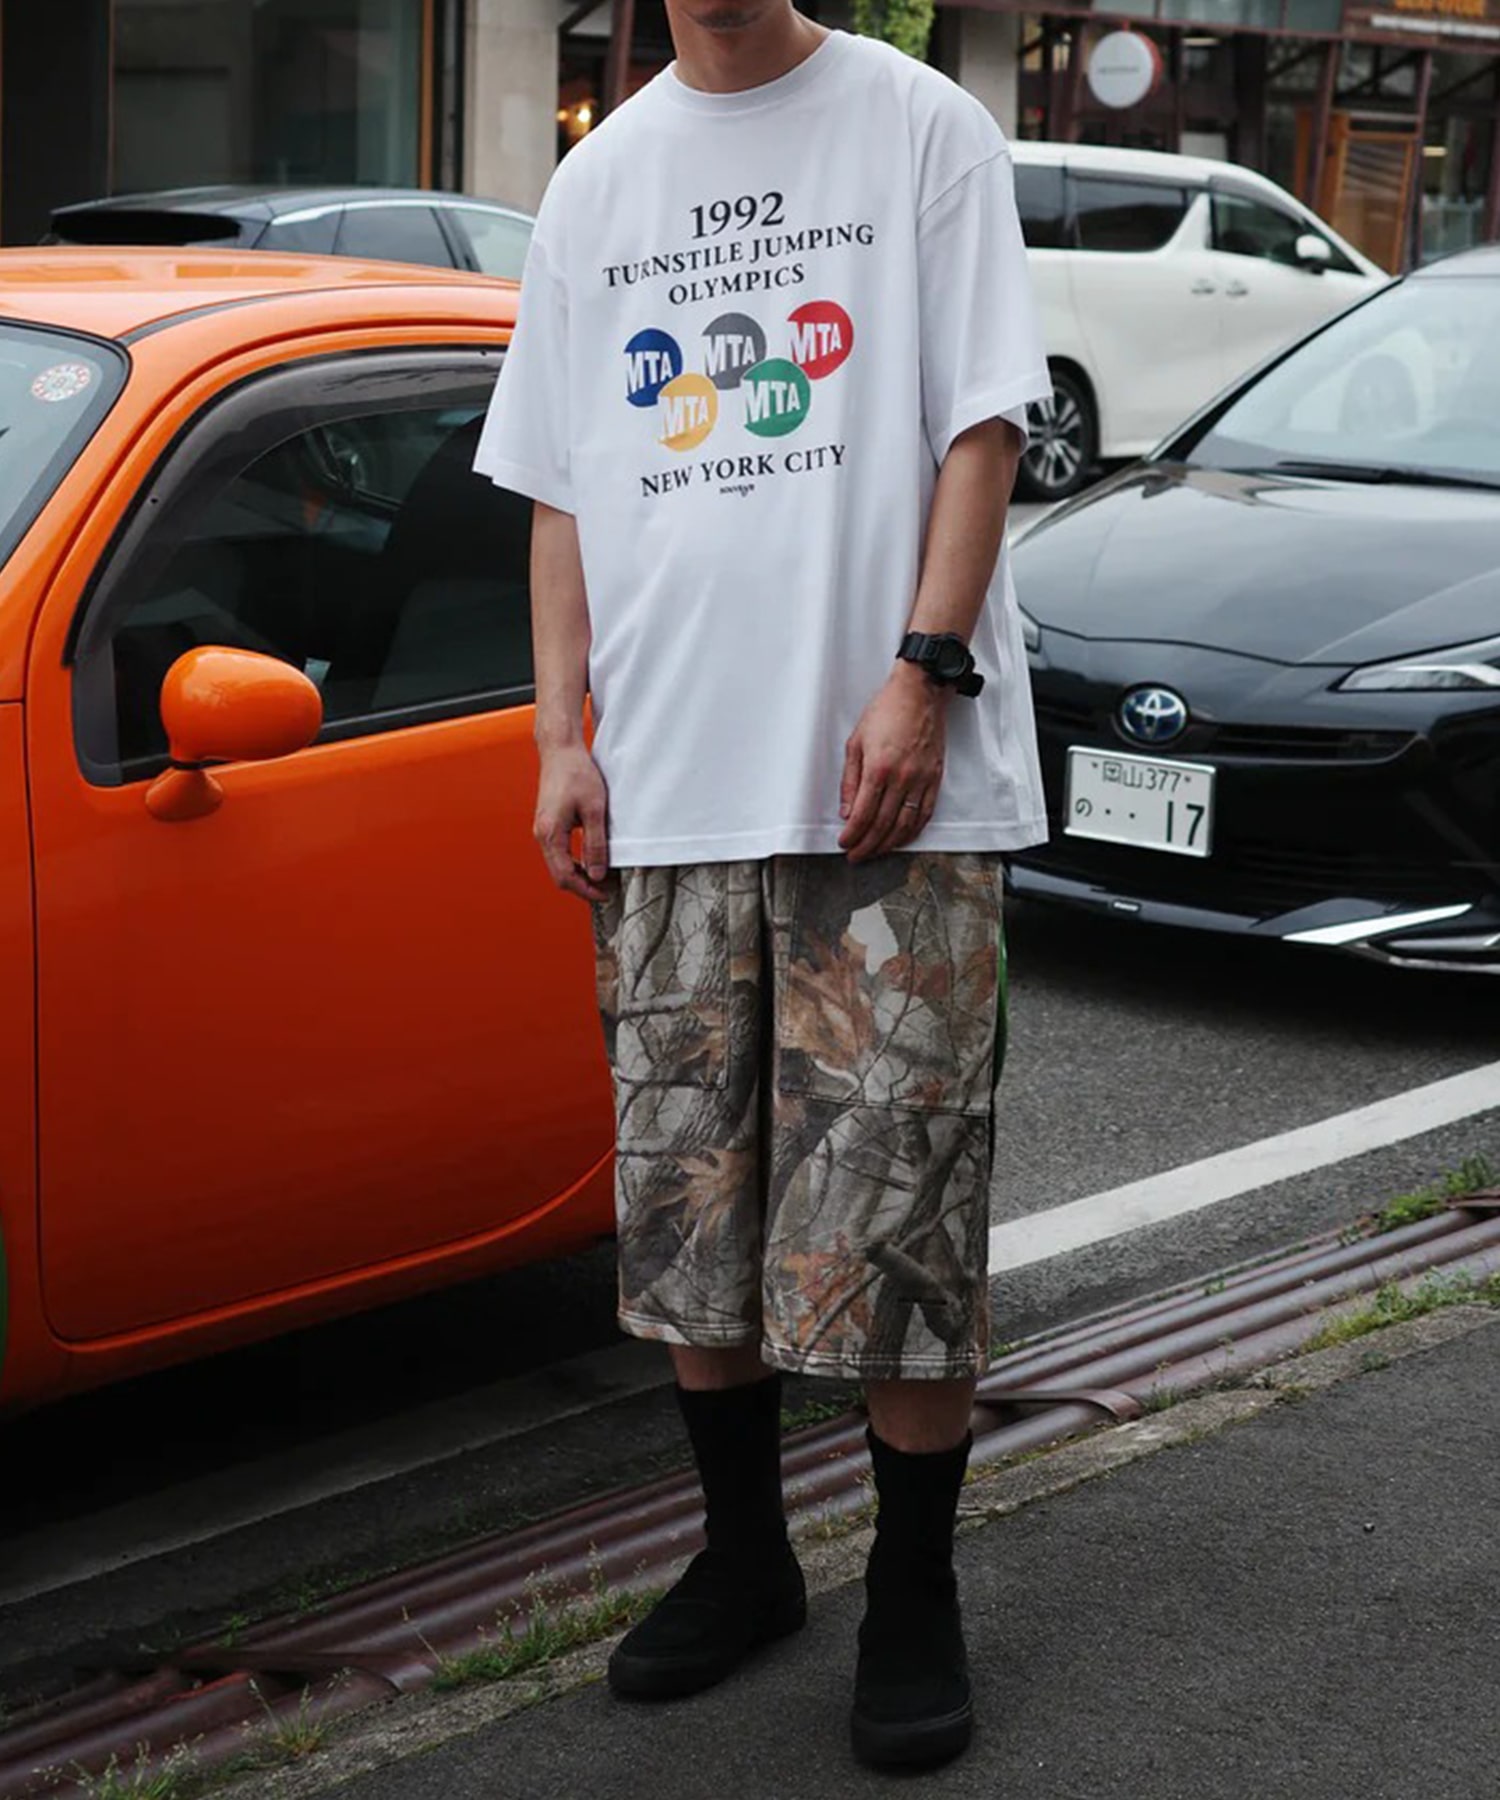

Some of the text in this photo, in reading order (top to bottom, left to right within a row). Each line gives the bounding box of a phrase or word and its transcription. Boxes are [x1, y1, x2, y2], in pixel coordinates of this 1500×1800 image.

[690, 191, 785, 240] 1992
[603, 224, 874, 287] TURNSTILE JUMPING
[669, 263, 804, 305] OLYMPICS
[702, 334, 756, 376] MTA
[787, 321, 842, 364] MTA
[625, 351, 673, 395] MTA
[660, 395, 709, 441] MTA
[744, 380, 801, 423] MTA
[641, 466, 692, 497] NEW
[700, 454, 775, 483] YORK
[784, 445, 846, 473] CITY
